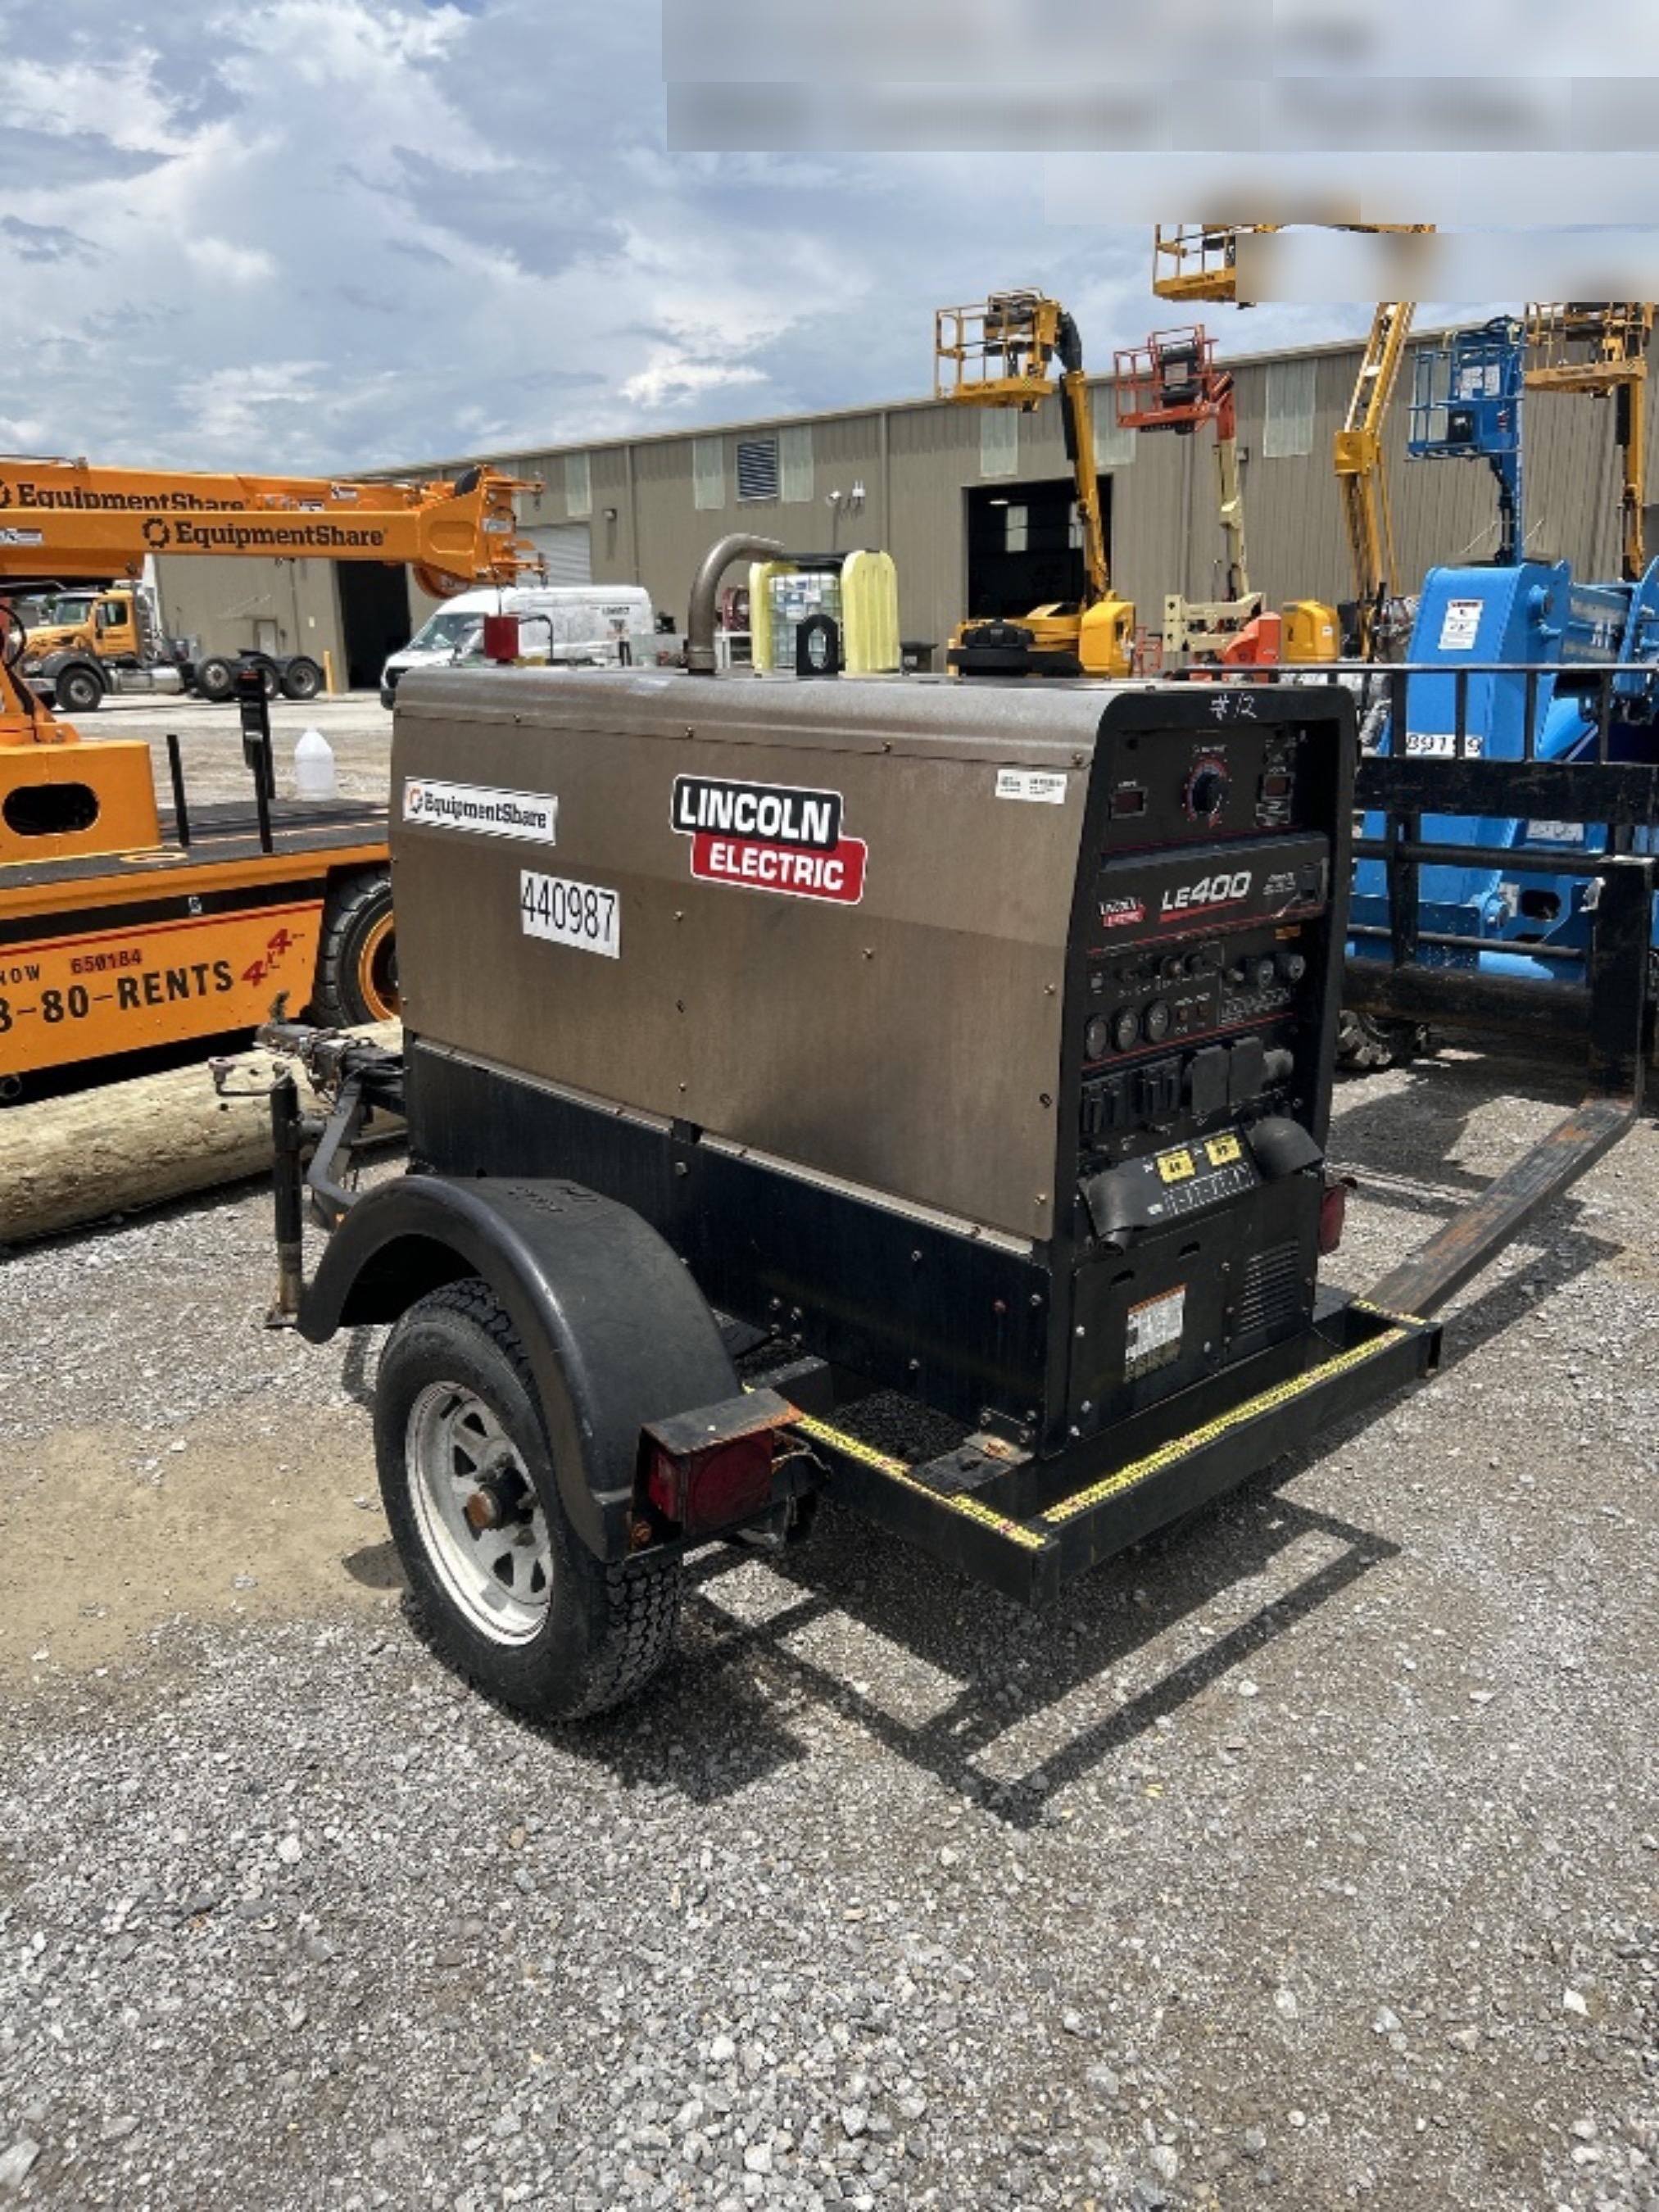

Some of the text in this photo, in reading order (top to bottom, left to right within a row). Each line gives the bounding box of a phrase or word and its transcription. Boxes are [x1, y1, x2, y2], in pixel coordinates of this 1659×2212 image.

[16, 484, 245, 510] EquipmentShare
[175, 521, 384, 548] EquipmentShare
[424, 791, 546, 829] EquipmentShare
[680, 786, 832, 844] LINCOLN
[709, 842, 844, 891] ELECTRIC
[522, 877, 614, 941] 440987
[1161, 869, 1252, 911] LE400
[70, 948, 142, 975] 650184
